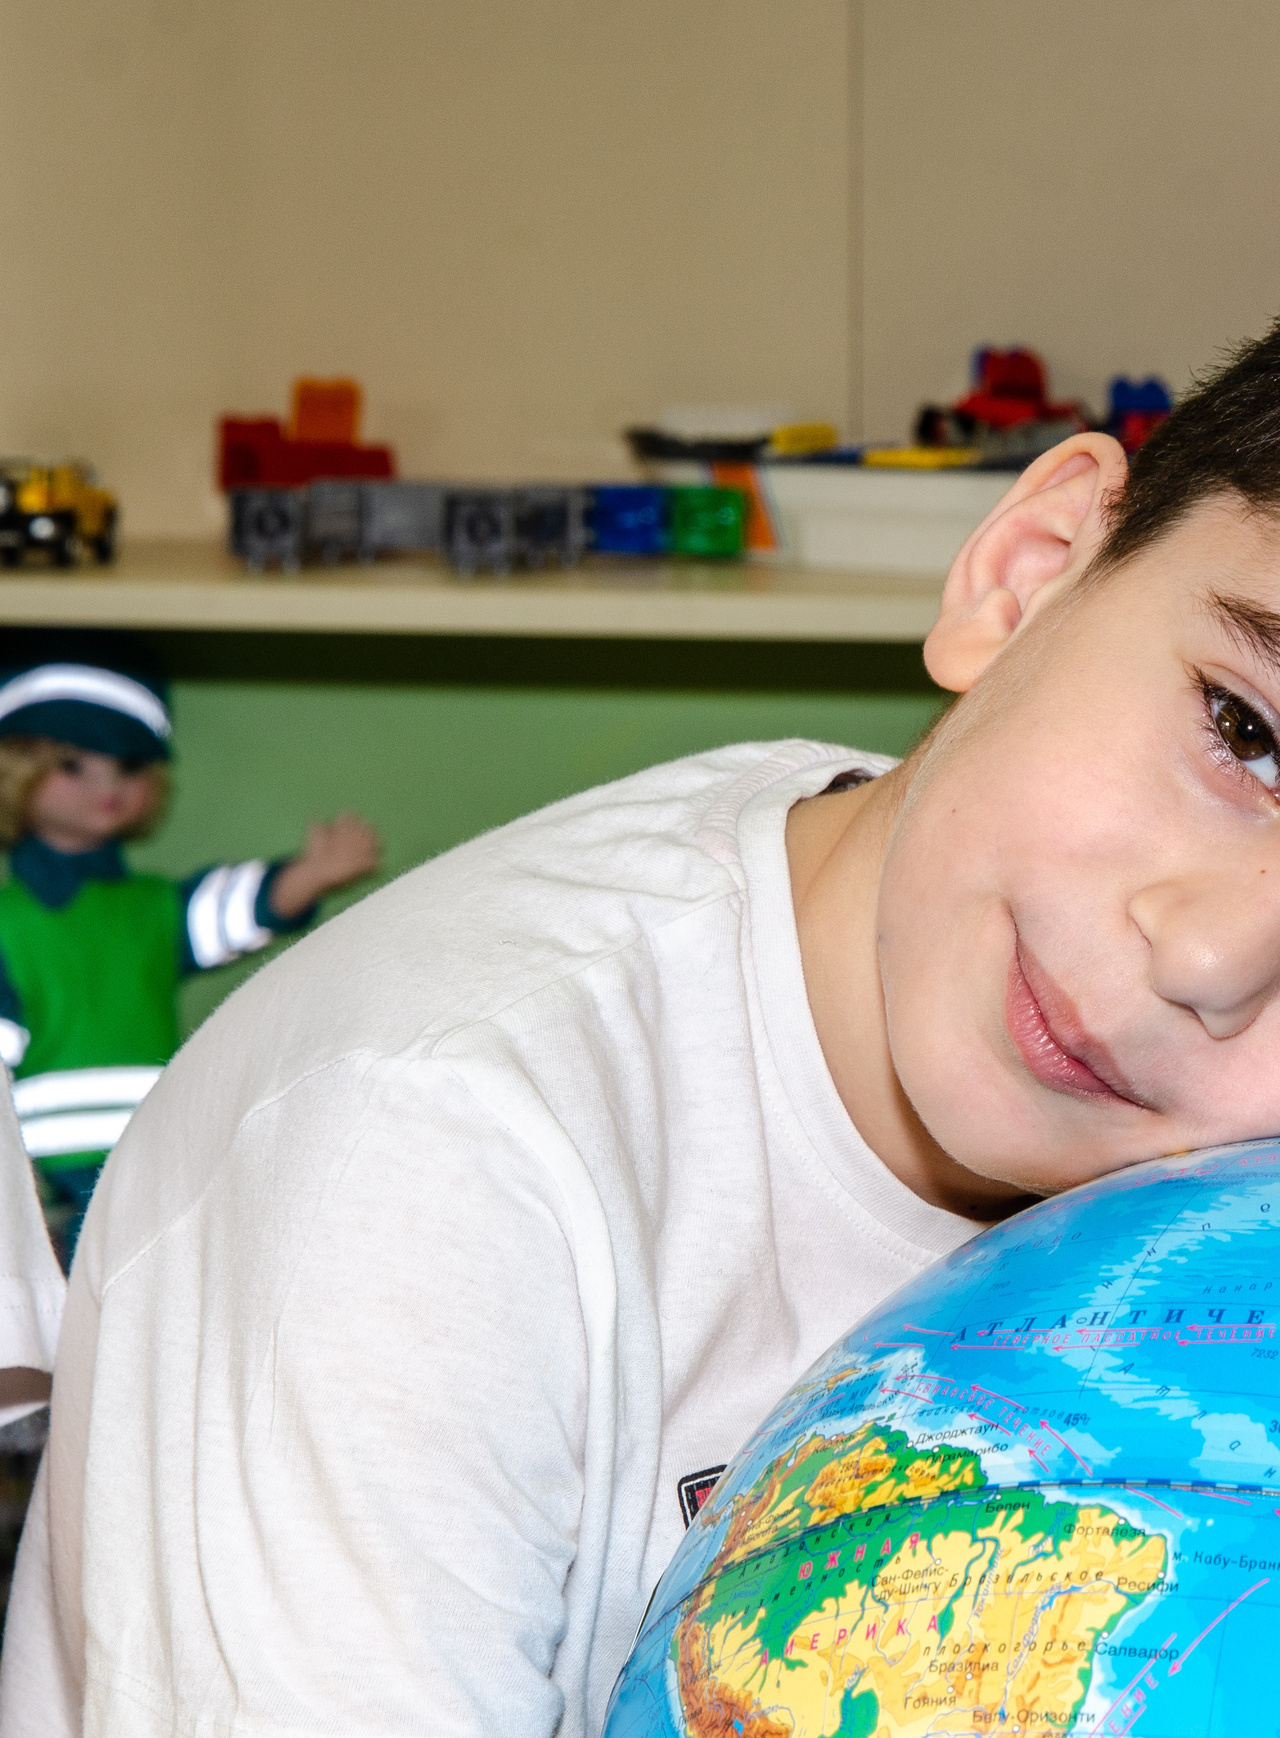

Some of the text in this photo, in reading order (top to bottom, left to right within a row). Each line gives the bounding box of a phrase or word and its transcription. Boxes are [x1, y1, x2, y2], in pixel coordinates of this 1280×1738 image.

[993, 1327, 1277, 1346] СЕВЕРНОЕ ПАССАТНОЕ ТЕЧЕНИЕ
[1250, 1348, 1279, 1360] 7232
[915, 1383, 1052, 1456] ГВИАНСКОЕ ТЕЧЕНИЕ
[1063, 1413, 1089, 1428] 45°
[915, 1423, 999, 1446] Джорджтаун
[925, 1442, 1009, 1465] Парамарибо
[985, 1500, 1030, 1514] Белен
[1063, 1523, 1146, 1538] Форталеза
[798, 1532, 920, 1581] ЮЖНАЯ
[871, 1566, 949, 1590] Сан-Фелис-
[1116, 1577, 1179, 1593] Ресифи
[874, 1580, 941, 1602] -ду-Шингу
[922, 1639, 1087, 1657] плоскогорье
[1095, 1642, 1180, 1662] Салвадор
[928, 1660, 999, 1674] Бразилиа
[904, 1695, 957, 1710] Гояния
[972, 1709, 1095, 1726] Белу-Оризонти
